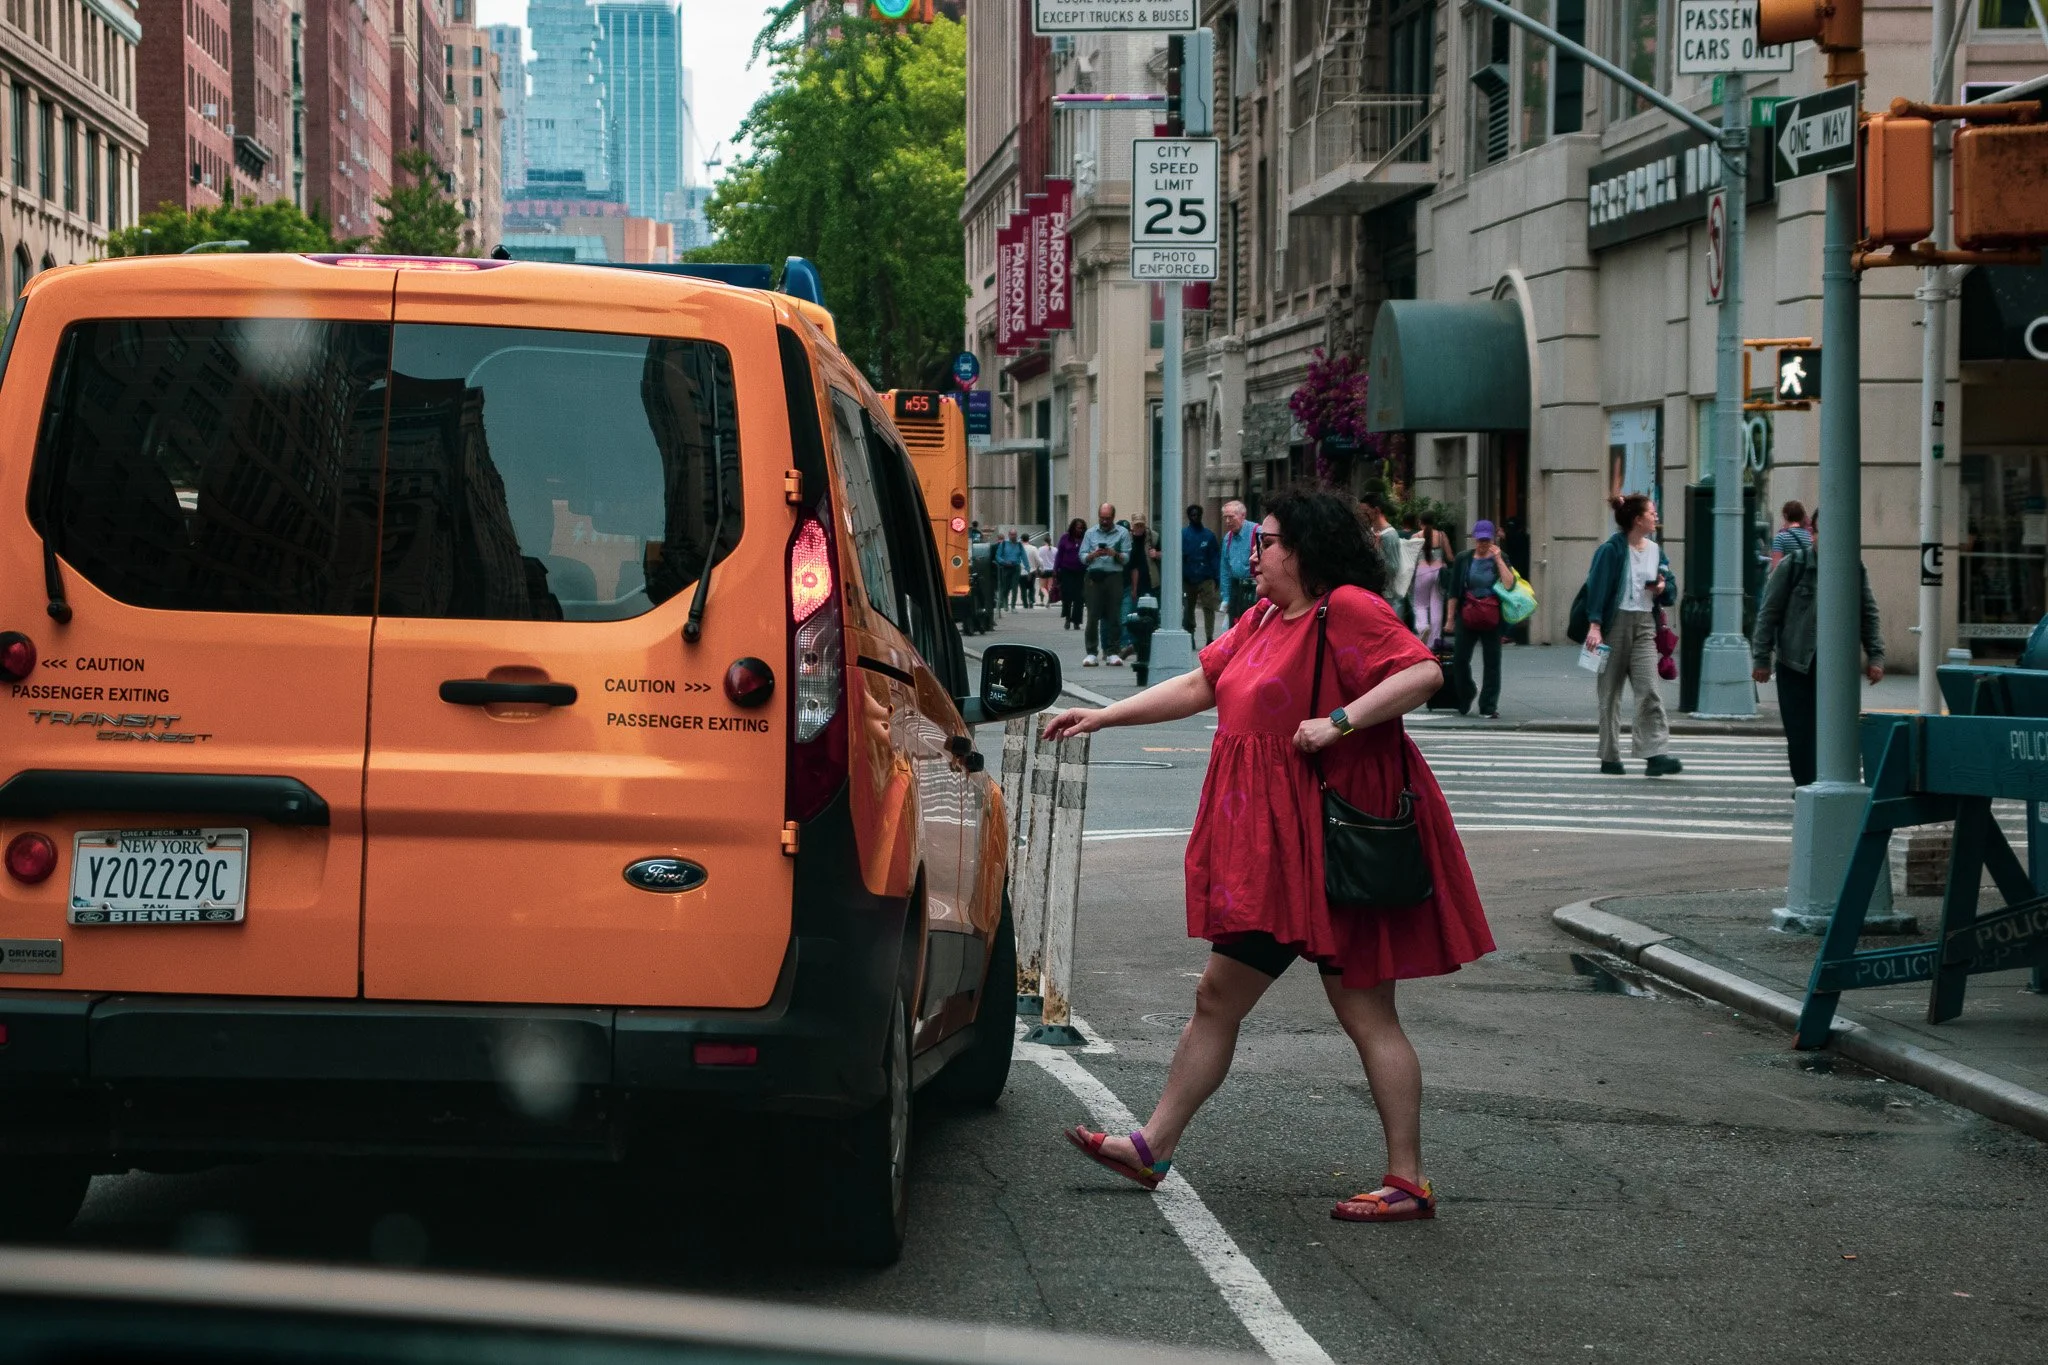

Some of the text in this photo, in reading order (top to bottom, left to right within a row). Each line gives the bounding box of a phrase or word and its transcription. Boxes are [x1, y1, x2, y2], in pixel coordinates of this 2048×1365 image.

[1043, 10, 1189, 23] EXCEPT TRUCKS & BUSES
[1685, 8, 1753, 30] PASSEN
[1685, 38, 1730, 60] CARS
[1789, 110, 1848, 155] ONE WAY
[1157, 146, 1192, 158] CITY
[1150, 163, 1198, 174] SPEED
[1155, 179, 1194, 191] LIMIT
[1144, 197, 1207, 235] 25
[1050, 212, 1065, 312] PARSONS
[1153, 252, 1196, 262] PHOTO
[1038, 214, 1048, 322] THE NEW SCHOOL
[1139, 264, 1210, 275] ENFORCED
[1012, 242, 1026, 332] PARSONS
[76, 657, 145, 672] CAUTION
[12, 685, 170, 703] PASSENGER EXITING
[604, 678, 675, 693] CAUTION
[28, 709, 181, 728] TRANSIT
[607, 713, 769, 733] PASSENGER EXITING
[2010, 730, 2048, 760] POLIC
[122, 830, 149, 838] GREAT
[119, 840, 204, 855] NEW YORK
[89, 856, 228, 901] Y202229C
[644, 863, 688, 884] Ford
[110, 910, 200, 922] BIENER
[8, 949, 57, 958] DRIVERGE
[1856, 954, 1933, 984] POLIC
